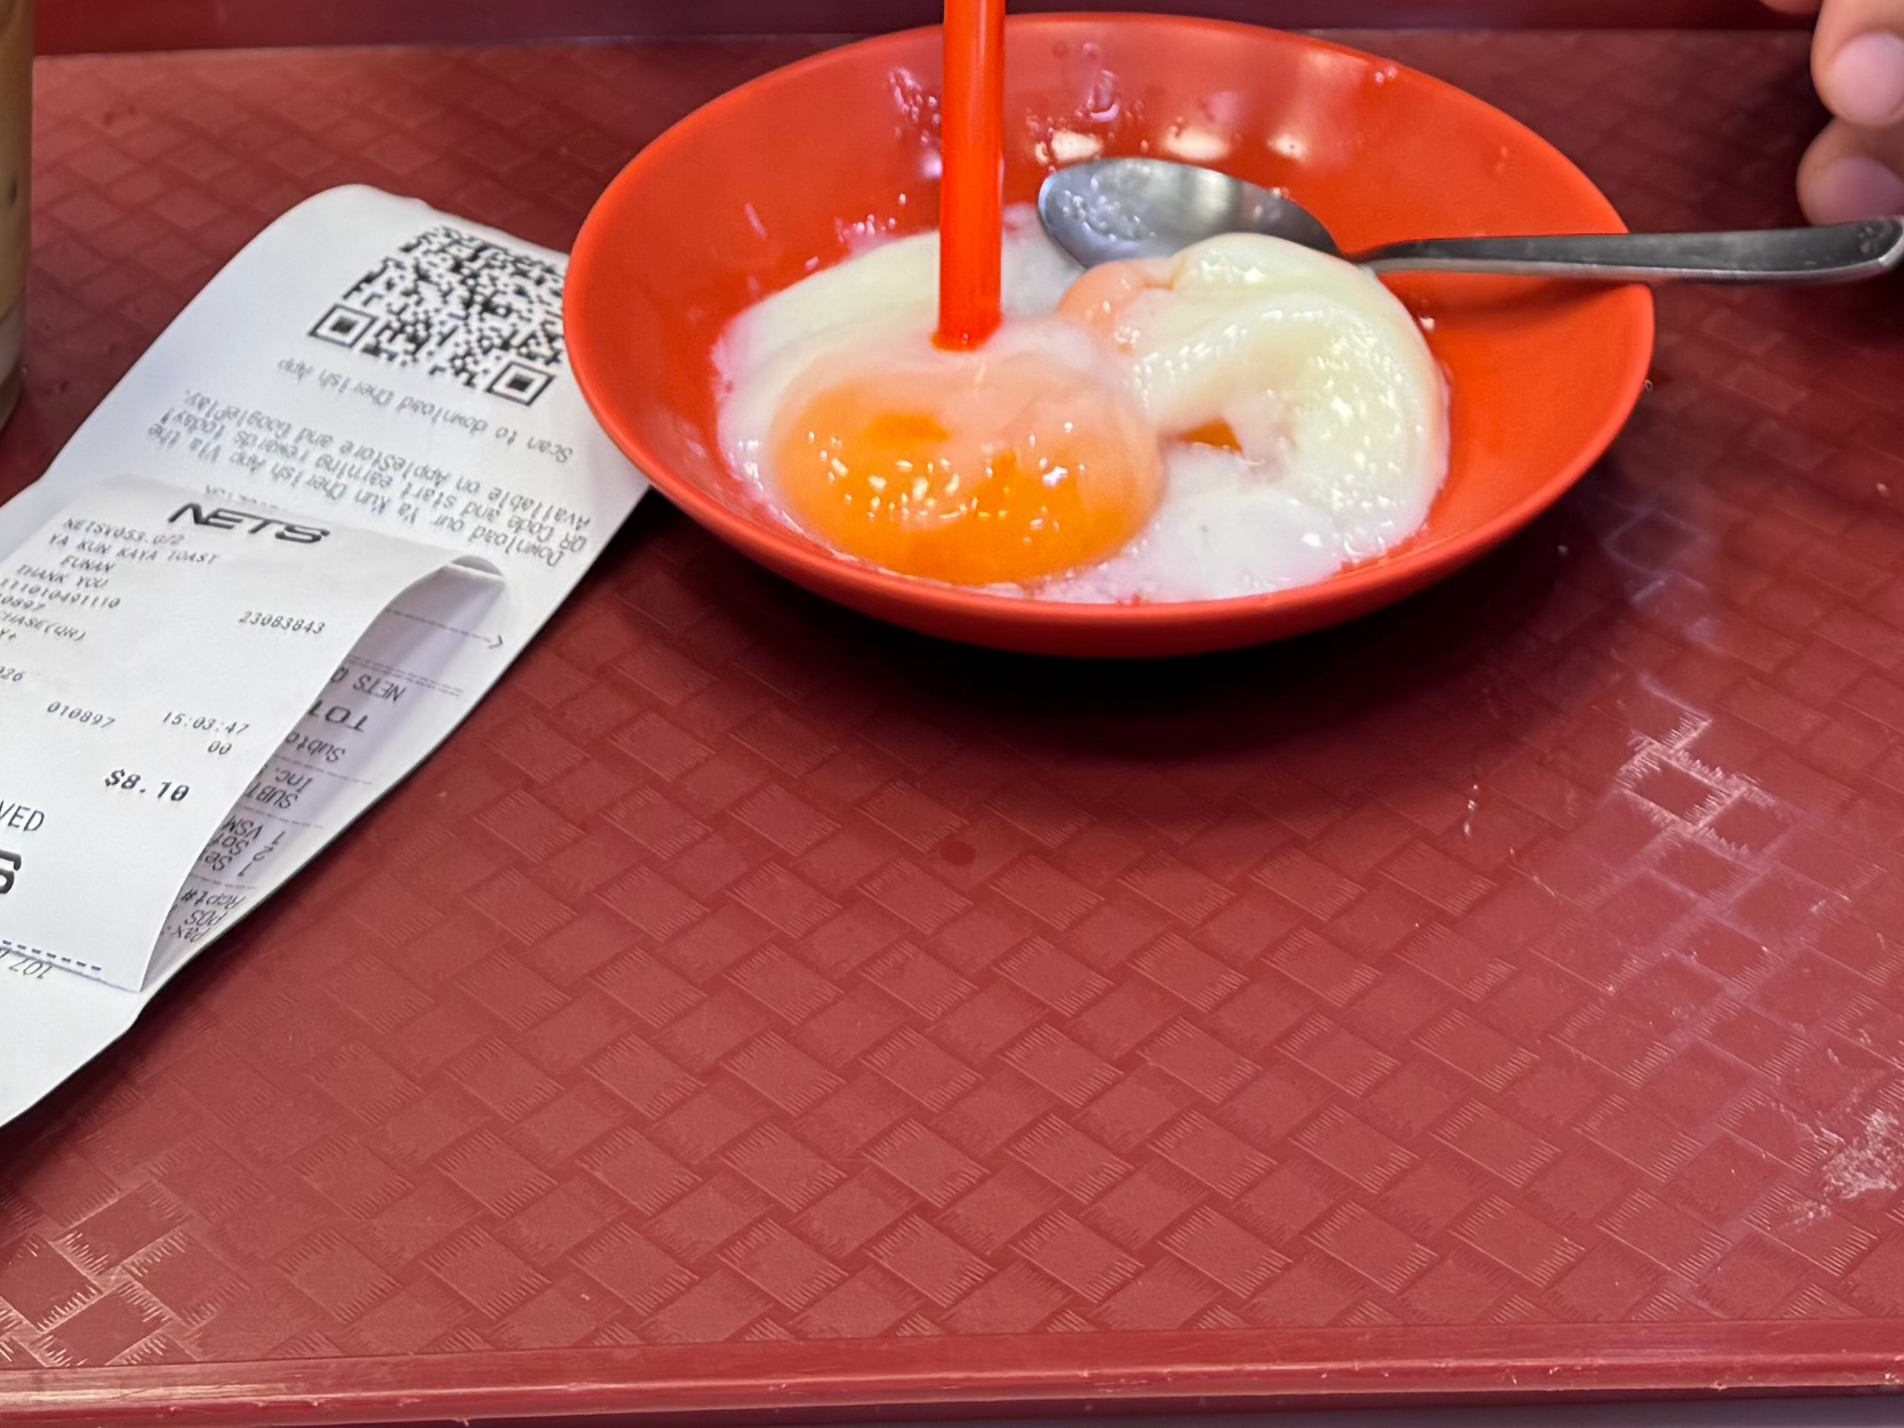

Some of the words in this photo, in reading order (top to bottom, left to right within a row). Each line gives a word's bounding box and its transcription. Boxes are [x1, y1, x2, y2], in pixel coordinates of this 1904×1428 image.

[278, 358, 314, 382] App
[318, 369, 394, 406] Cherish
[160, 407, 226, 440] today!
[396, 395, 488, 435] download
[147, 422, 181, 449] the
[233, 431, 309, 462] rewards
[295, 426, 334, 448] and
[495, 425, 518, 446] to
[229, 451, 266, 474] App
[527, 436, 573, 464] Scan
[315, 453, 394, 490] earning
[339, 441, 450, 488] AppleStore
[271, 462, 349, 500] Cherish
[455, 476, 481, 494] on
[355, 488, 392, 515] Kun
[400, 481, 458, 510] start
[488, 487, 592, 531] Available
[168, 501, 330, 544] NETS
[397, 502, 420, 525] Ya
[433, 514, 465, 532] our
[460, 501, 501, 523] and
[507, 515, 555, 542] Code
[48, 532, 69, 548] YA
[76, 538, 113, 557] KUN
[116, 545, 159, 562] KAYA
[167, 549, 222, 566] TOAST
[468, 524, 566, 567] Download
[559, 532, 588, 554] QR
[16, 563, 70, 585] THANK
[75, 573, 109, 590] YOU
[59, 554, 116, 574] FUNAN
[238, 610, 326, 635] 23083843
[352, 674, 408, 703] NETS
[45, 700, 117, 731] 010897
[161, 710, 252, 737] 15:03:47
[206, 740, 234, 756] 00
[102, 766, 192, 803] $8.10
[270, 829, 286, 846] 1
[252, 845, 274, 862] 2
[236, 860, 254, 877] 1
[180, 889, 246, 911] Rcpt#
[184, 909, 228, 926] POS
[9, 956, 56, 980] 107
